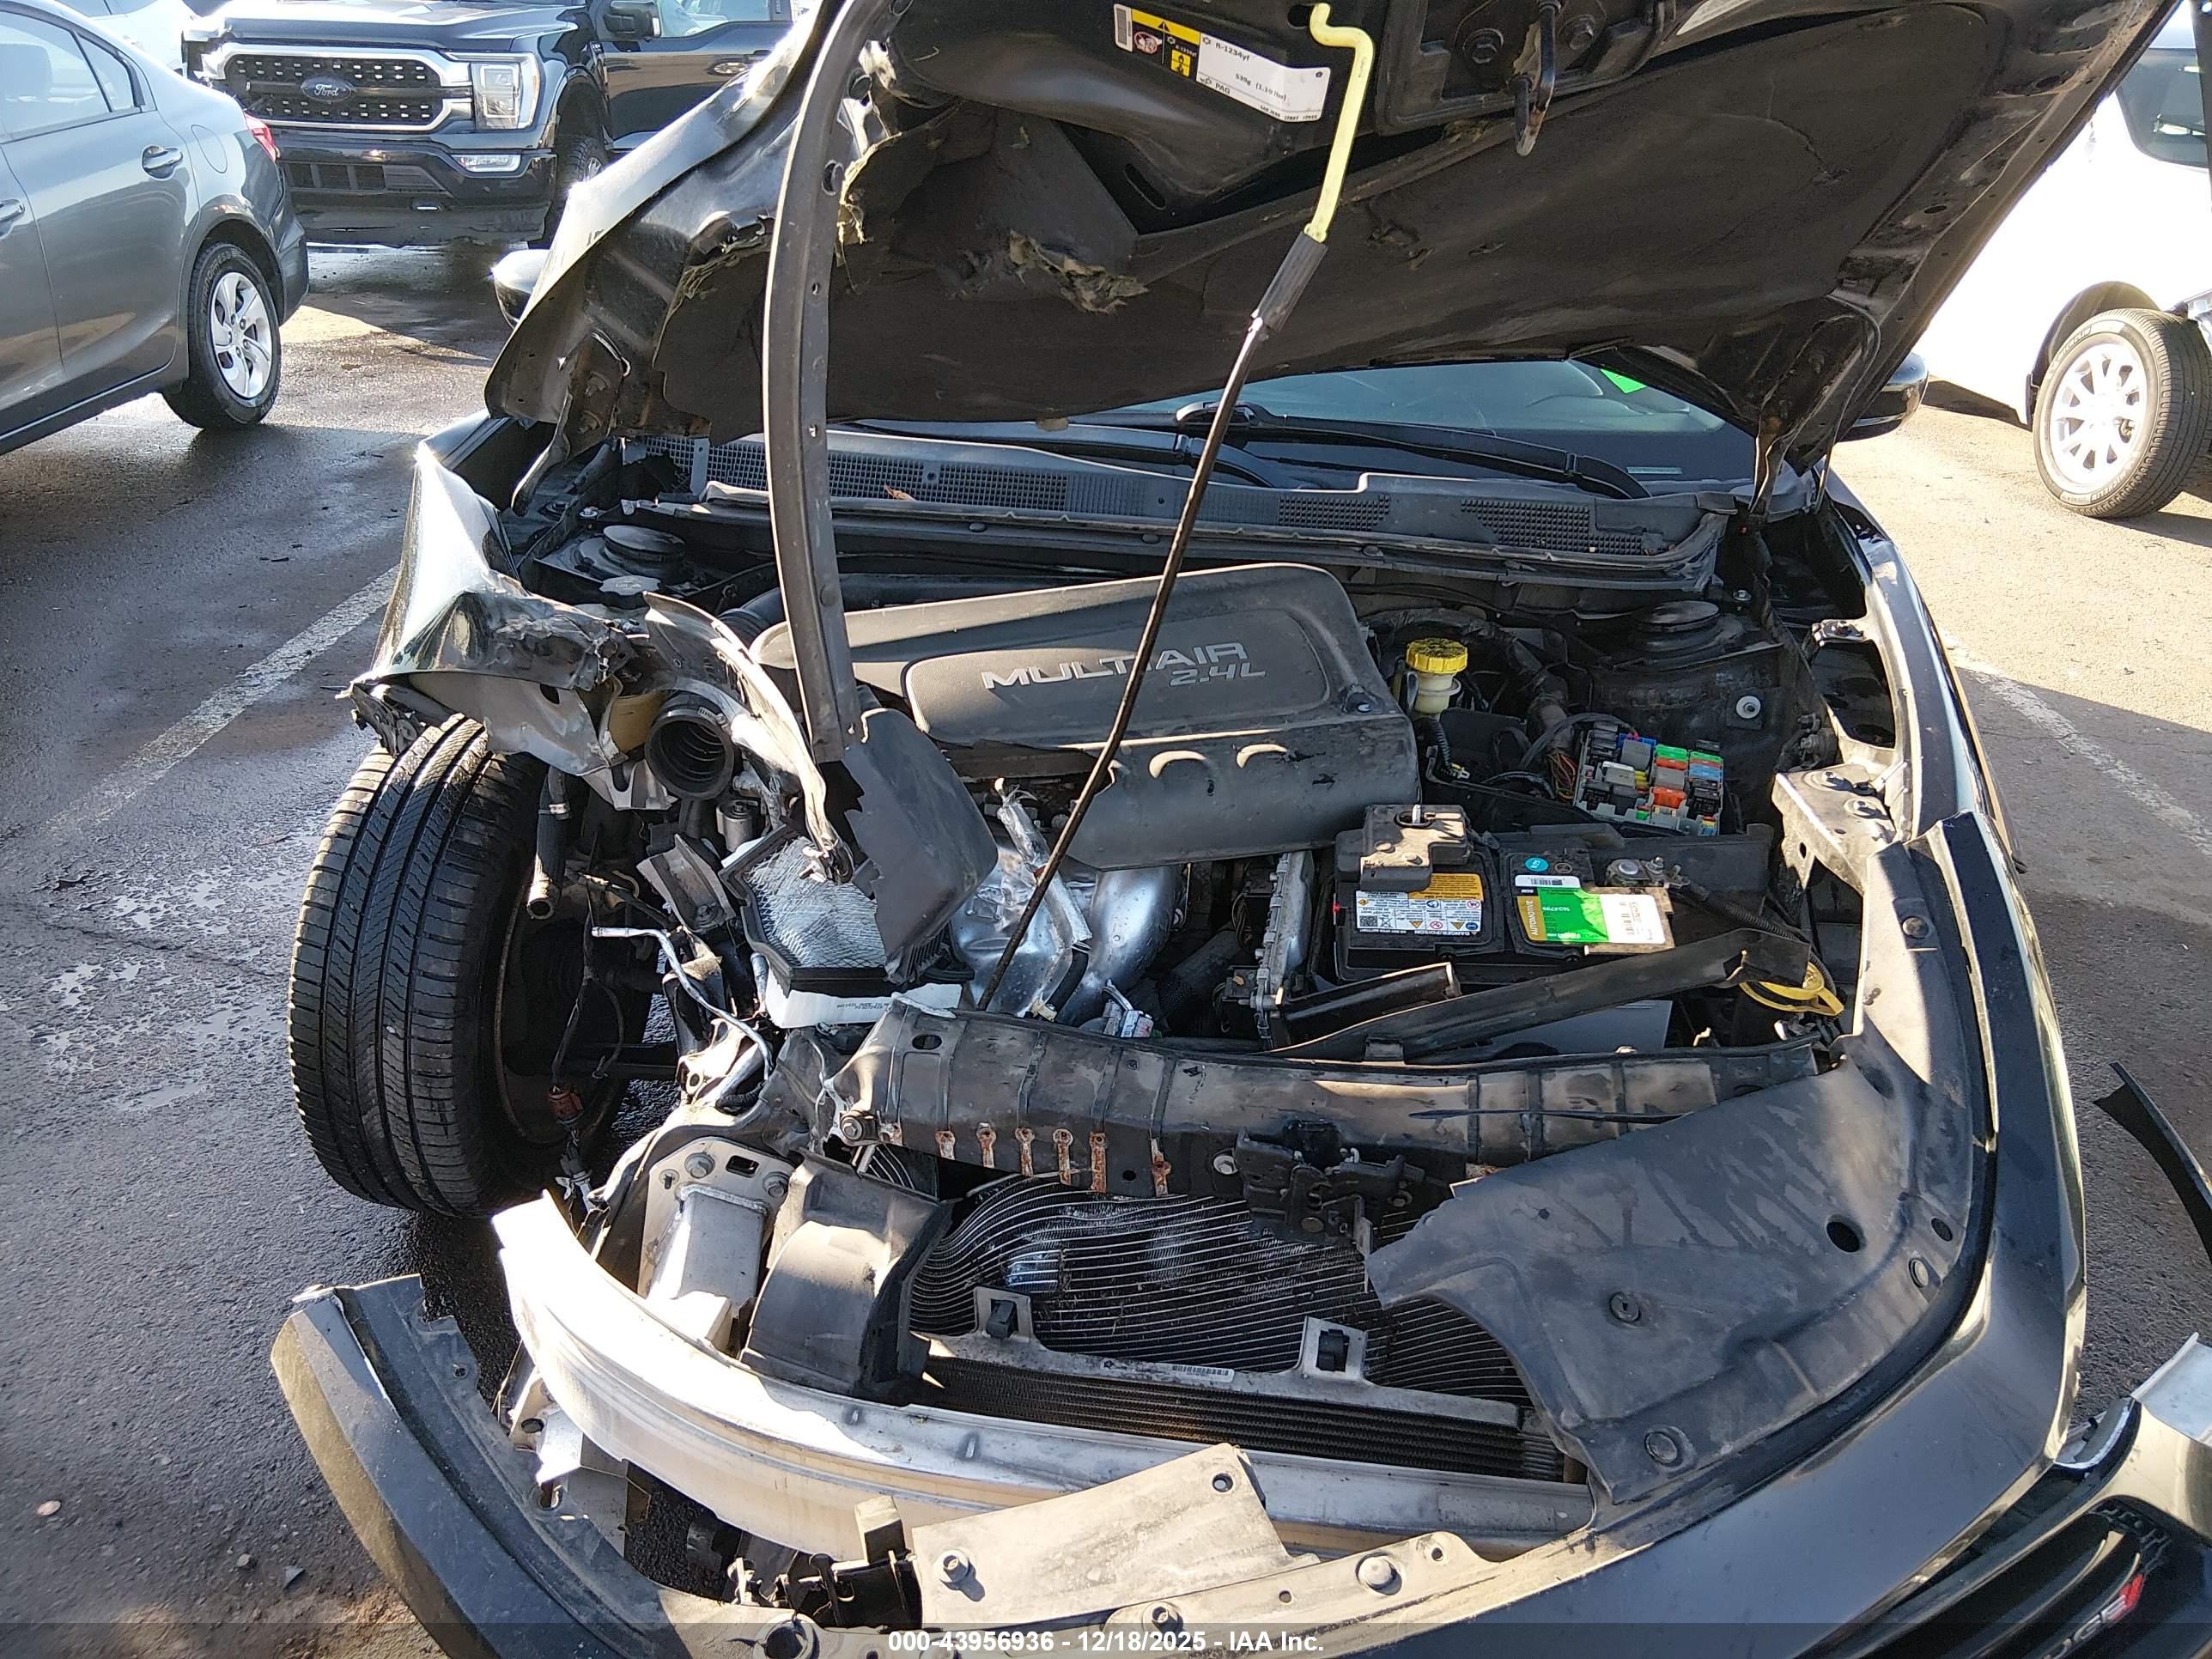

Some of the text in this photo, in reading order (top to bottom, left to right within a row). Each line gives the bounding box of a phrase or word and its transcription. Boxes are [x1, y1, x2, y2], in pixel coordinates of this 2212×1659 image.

[1215, 42, 1250, 62] R-1234yf
[314, 83, 339, 96] Ford
[1215, 82, 1231, 94] PAG
[981, 642, 1249, 690] MULTAIR
[1170, 662, 1267, 687] 2.4L
[1526, 900, 1539, 935] AUTOMOTIVE
